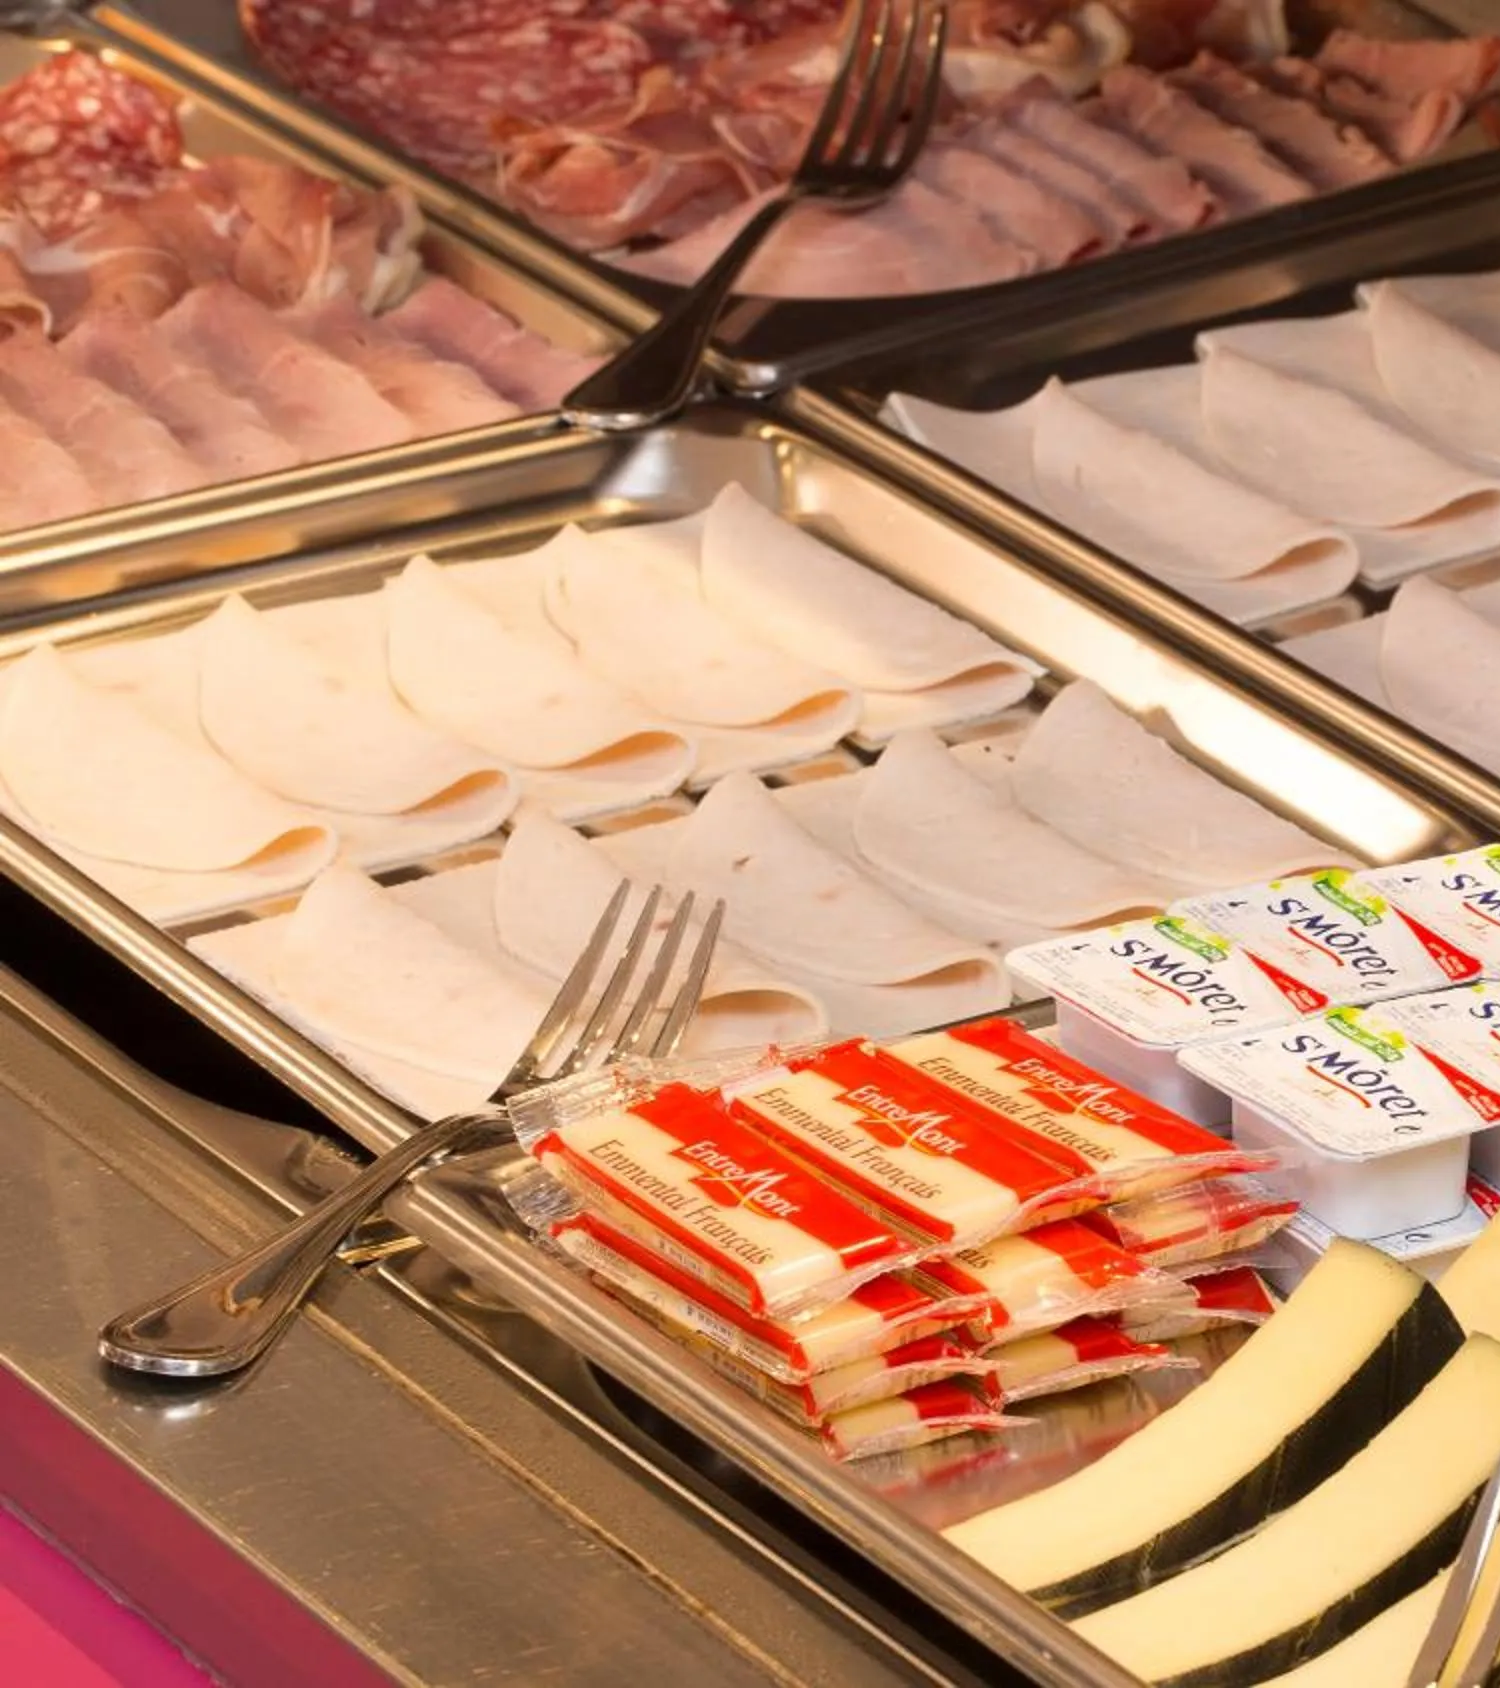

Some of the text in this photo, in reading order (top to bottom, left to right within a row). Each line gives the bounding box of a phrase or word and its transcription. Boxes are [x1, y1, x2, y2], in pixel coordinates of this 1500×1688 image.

[917, 1057, 1033, 1115] Emmental
[753, 1087, 943, 1200] Emmental Français
[588, 1139, 693, 1211] Emmental
[684, 1204, 774, 1265] Français
